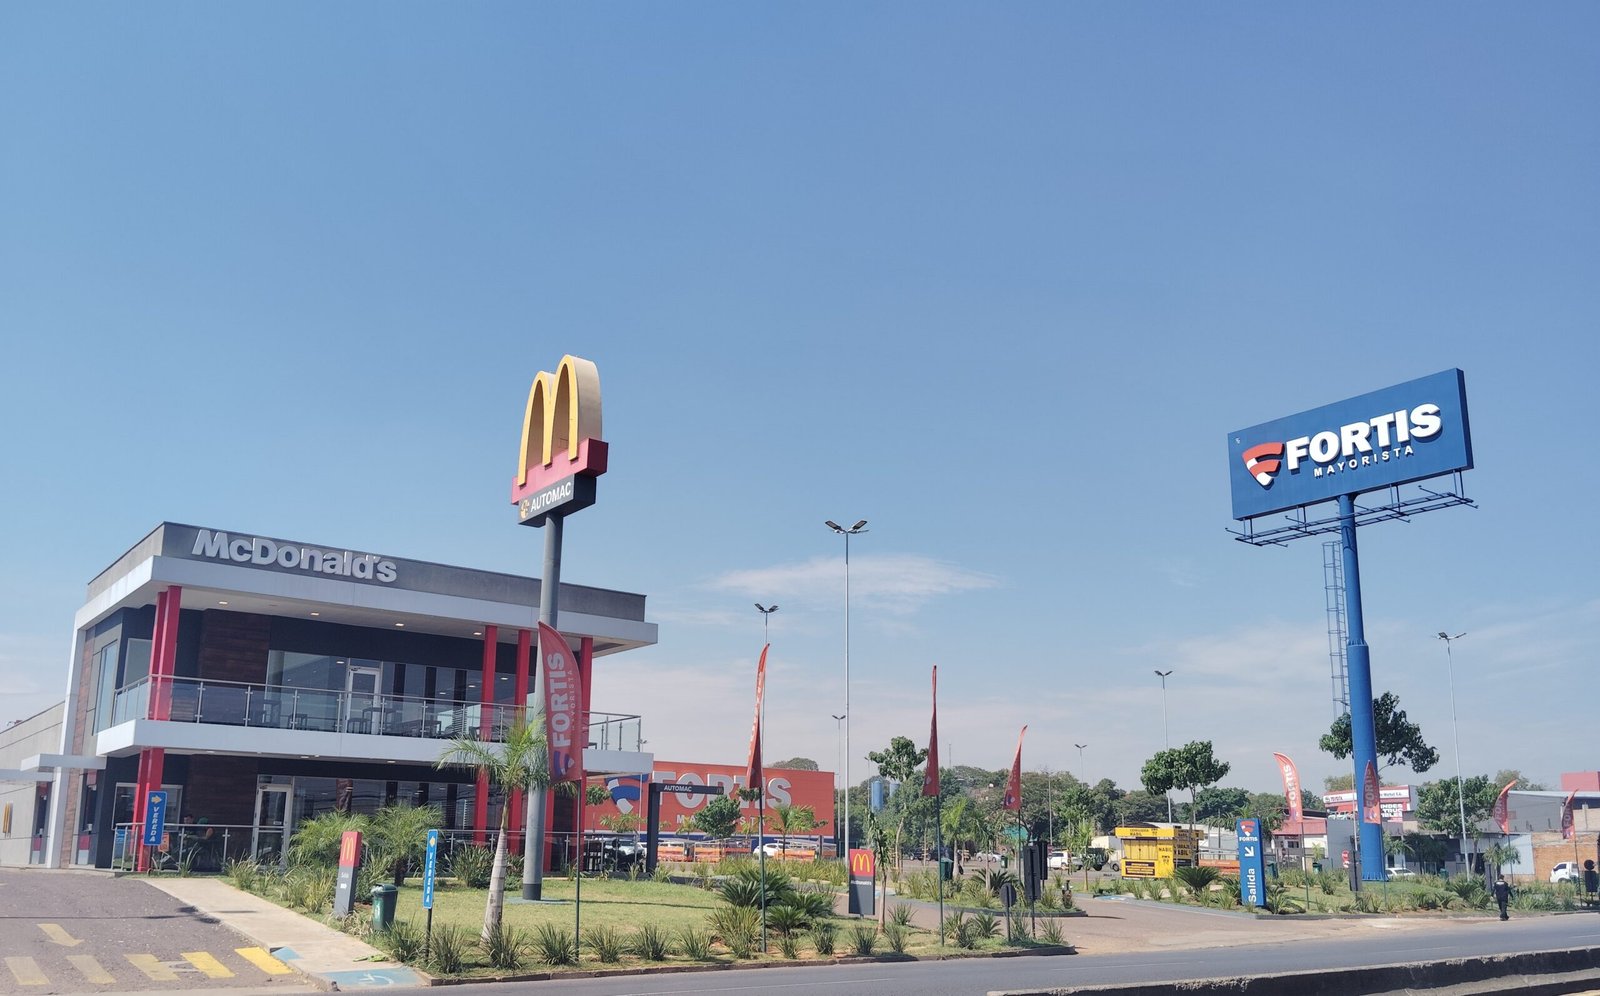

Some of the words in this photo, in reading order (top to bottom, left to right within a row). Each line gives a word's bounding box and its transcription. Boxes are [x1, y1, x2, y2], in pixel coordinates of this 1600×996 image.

[1286, 403, 1441, 470] FORTIS
[1314, 444, 1414, 478] MAYORISTA
[530, 481, 571, 513] AUTOMAC
[191, 529, 398, 583] McDonald's
[547, 652, 571, 748] FORTIS
[663, 784, 692, 792] AUTOMAC
[149, 806, 160, 842] VEREDA
[1247, 868, 1257, 902] Salida
